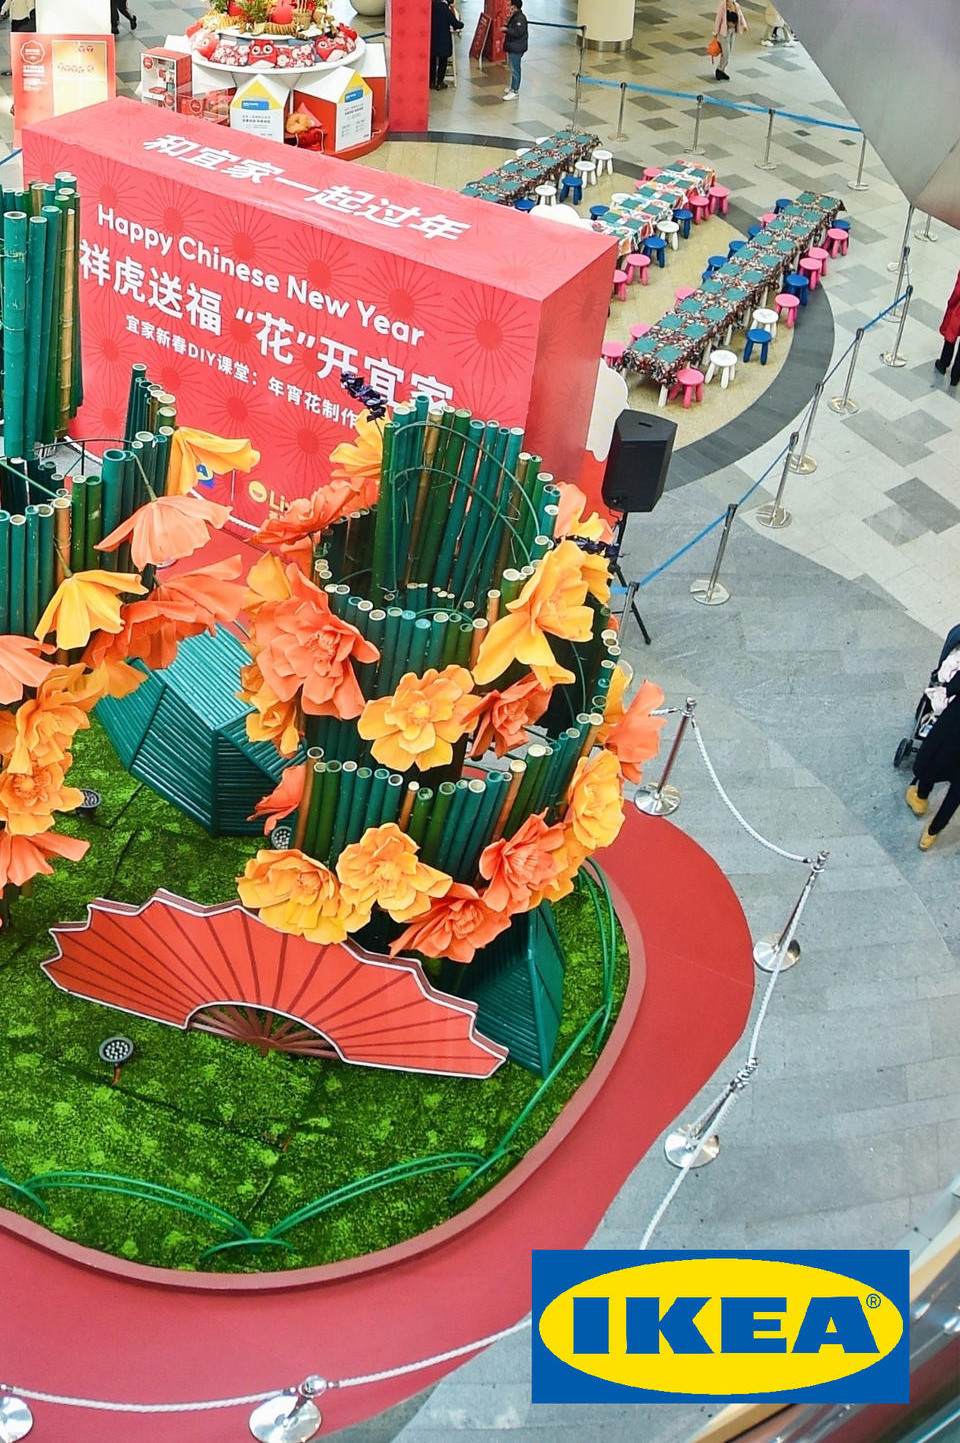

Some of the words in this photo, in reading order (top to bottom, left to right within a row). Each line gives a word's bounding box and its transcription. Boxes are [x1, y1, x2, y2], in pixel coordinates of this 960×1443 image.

[142, 133, 472, 241] 和宜家一起过年
[98, 204, 173, 256] Happy
[178, 236, 280, 294] Chinese
[287, 275, 350, 319] New
[356, 300, 425, 347] Year
